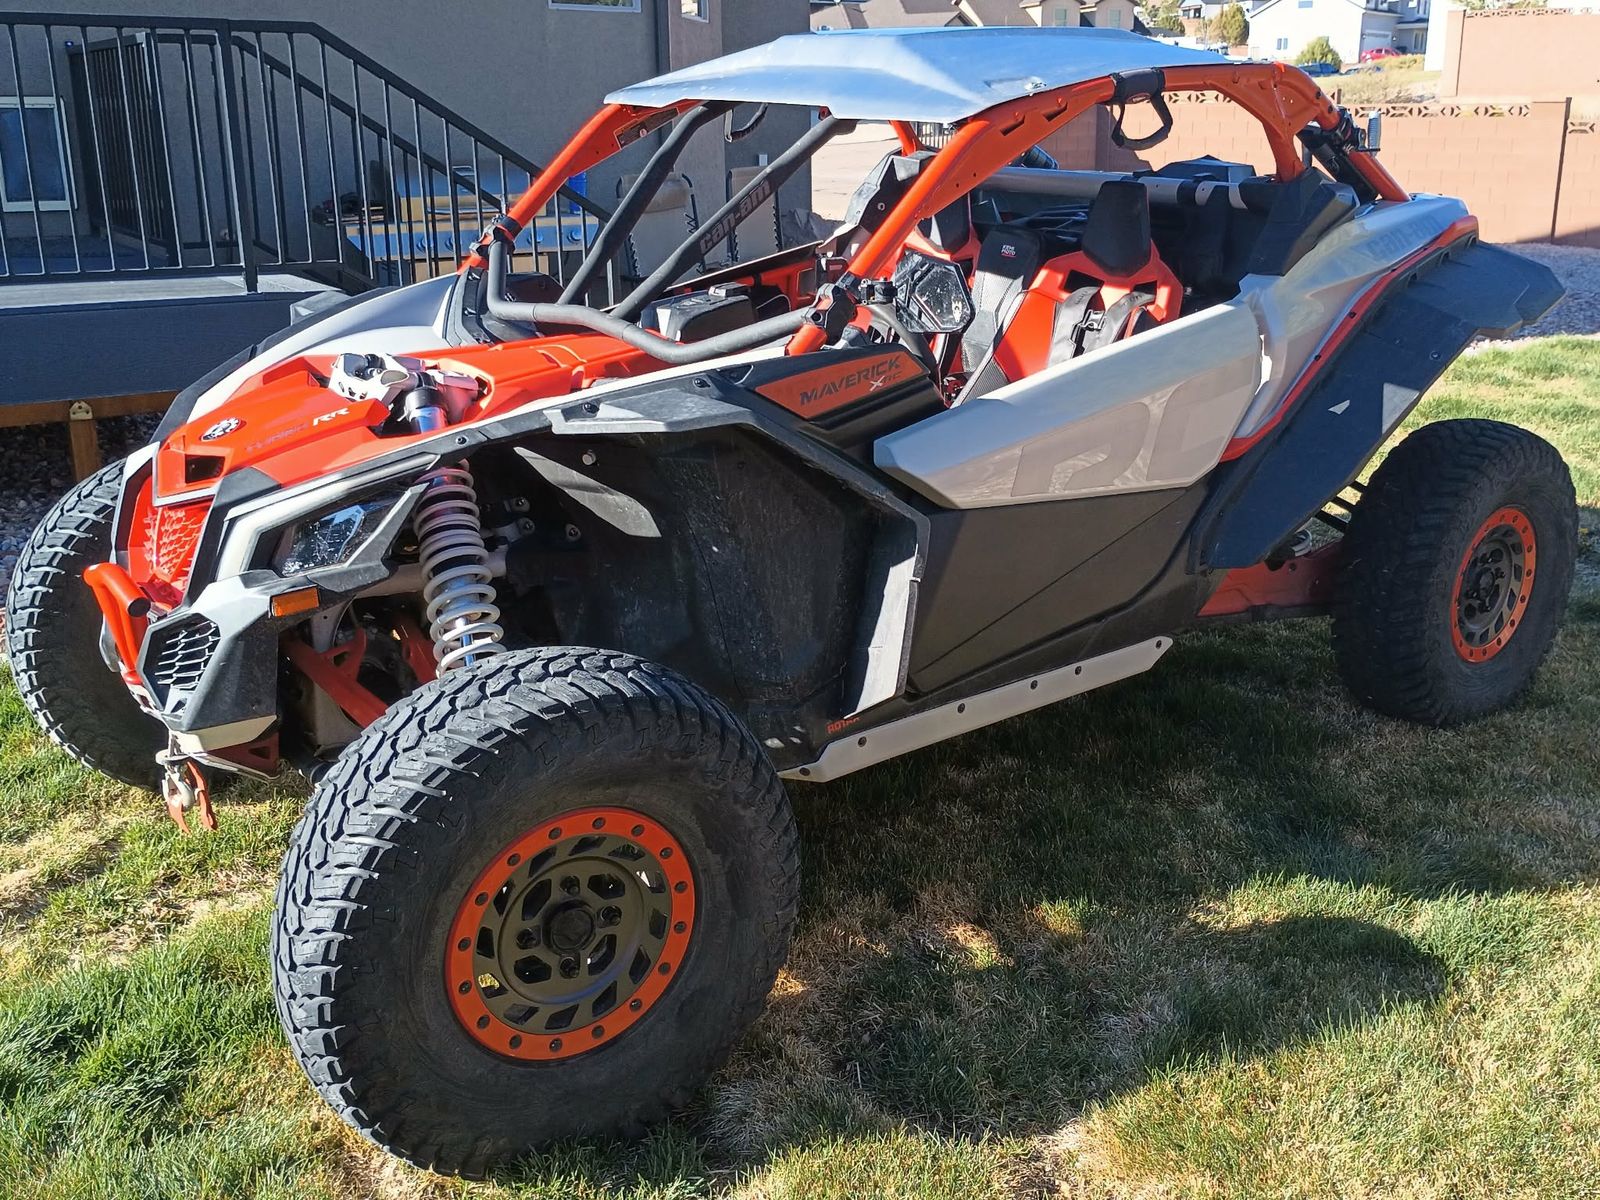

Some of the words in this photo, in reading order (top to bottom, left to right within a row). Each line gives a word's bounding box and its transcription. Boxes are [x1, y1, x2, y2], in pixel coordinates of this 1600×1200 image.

[700, 180, 772, 255] can-am
[799, 354, 901, 406] MAVERICK
[312, 407, 350, 426] RR
